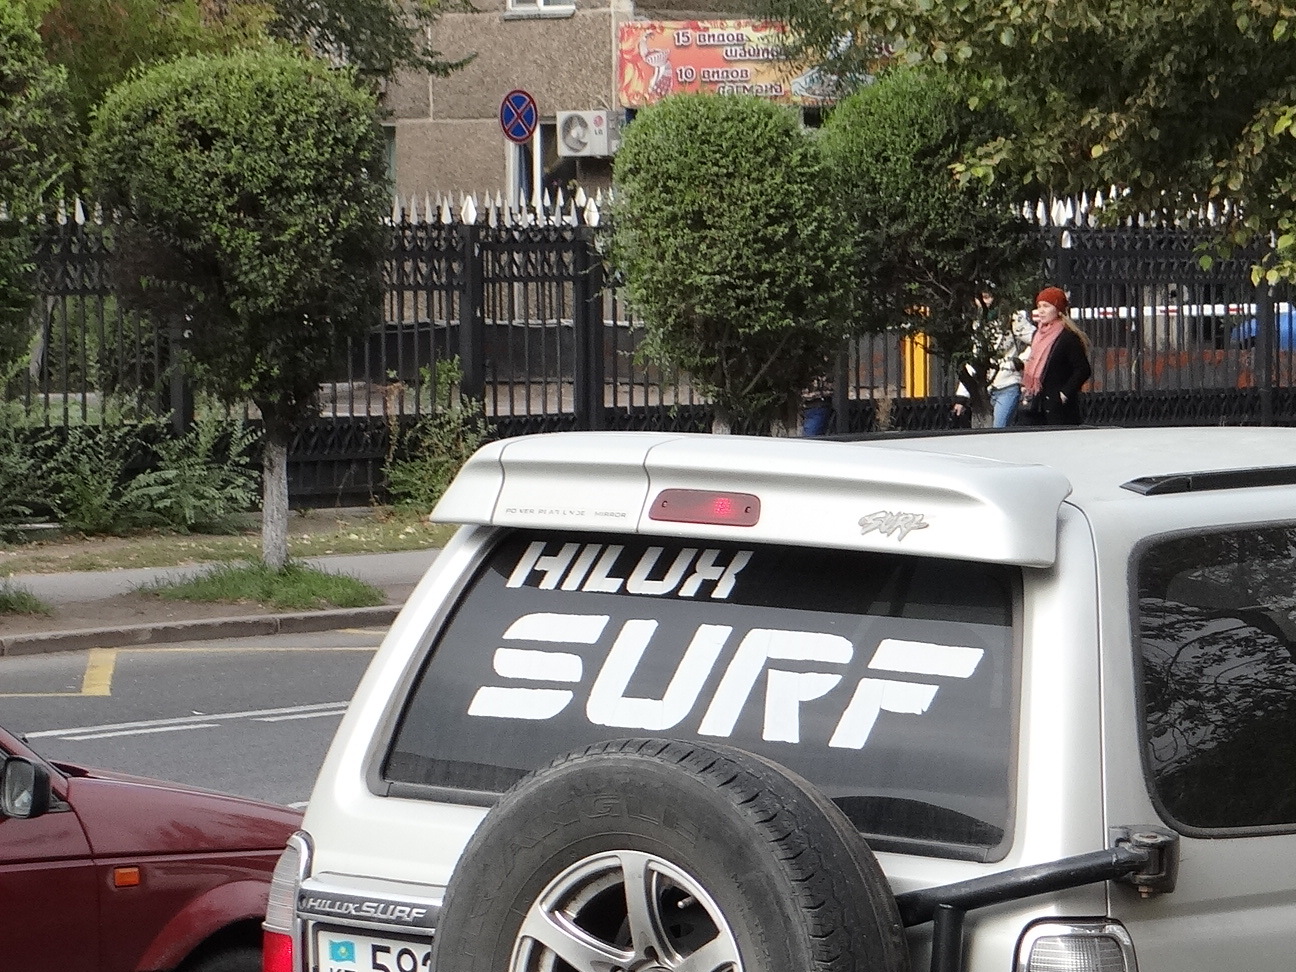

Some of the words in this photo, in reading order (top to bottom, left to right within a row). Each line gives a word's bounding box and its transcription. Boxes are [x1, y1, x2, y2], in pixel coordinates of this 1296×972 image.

[674, 31, 692, 45] 15
[677, 68, 696, 82] 10
[505, 541, 755, 599] HILUX
[468, 612, 985, 750] SURF
